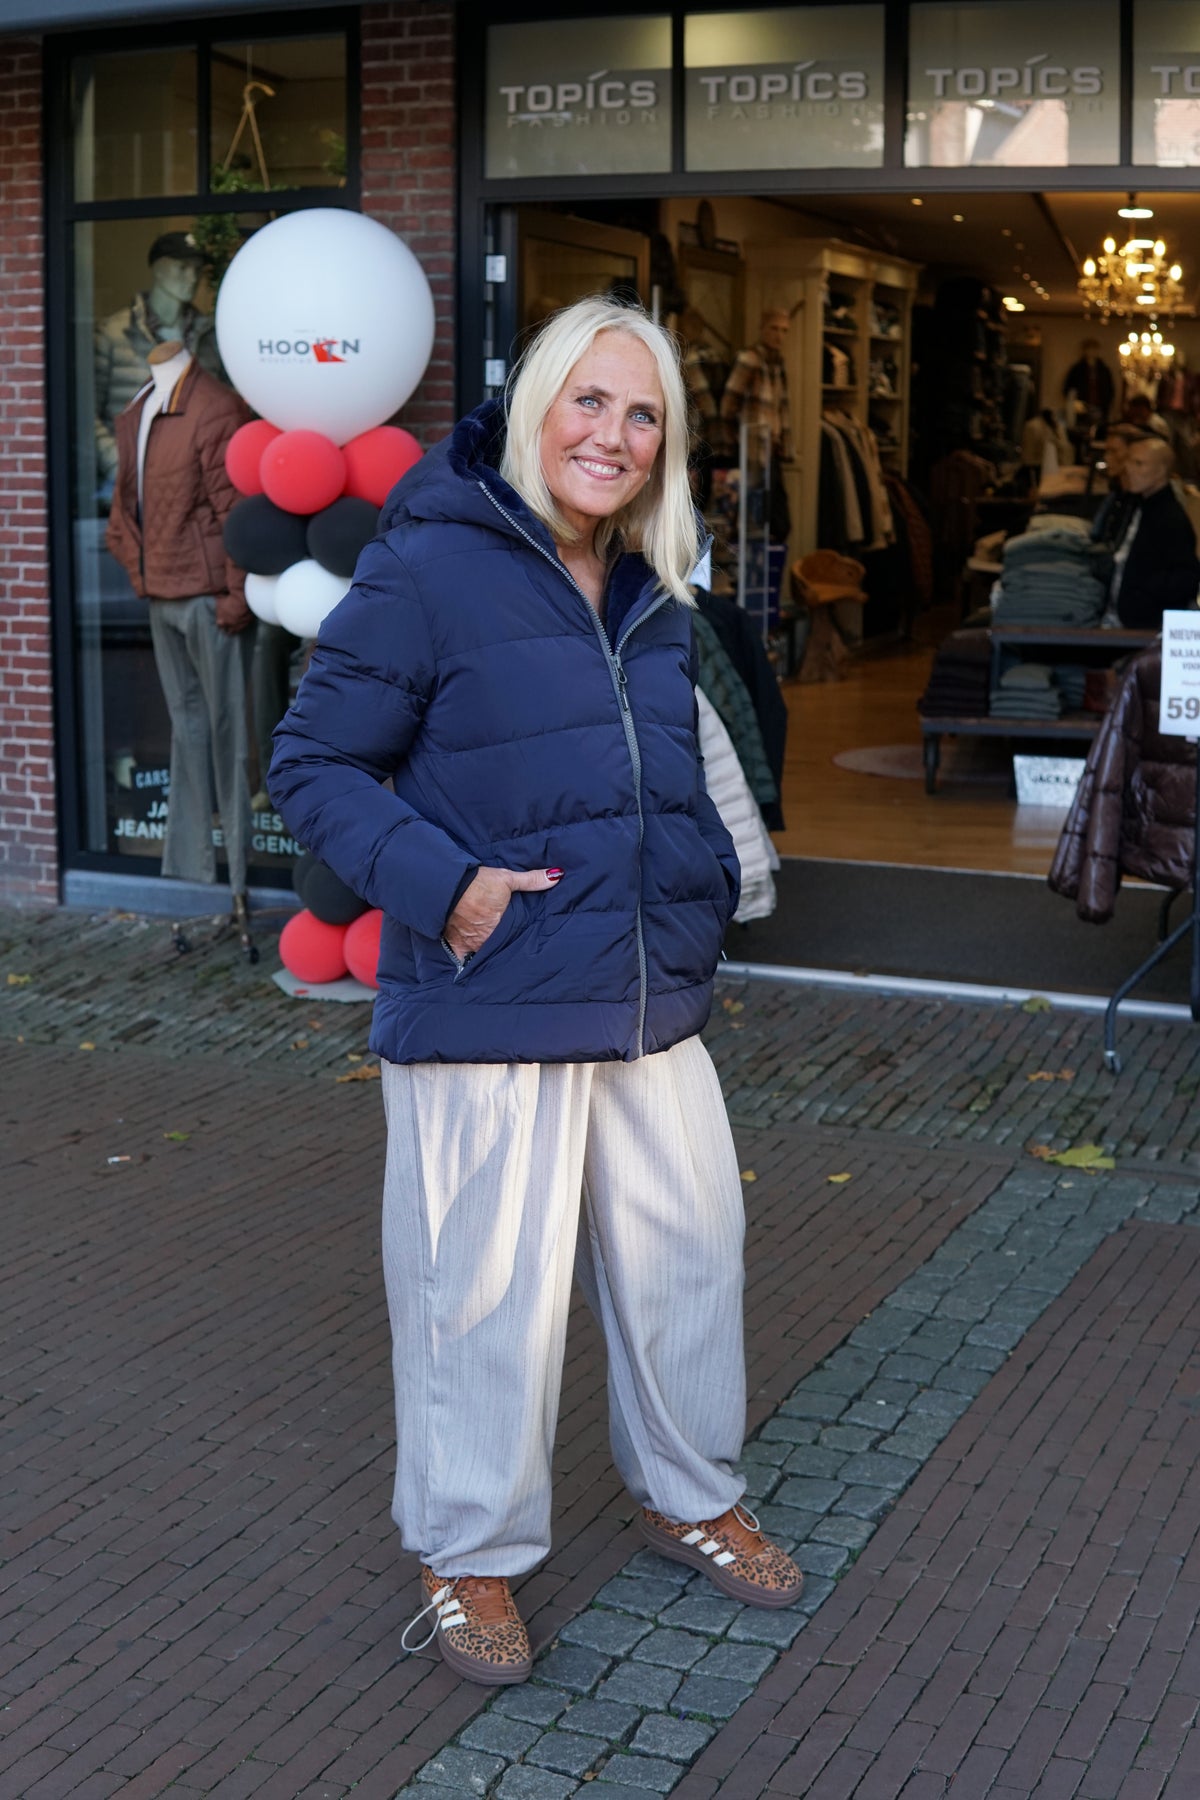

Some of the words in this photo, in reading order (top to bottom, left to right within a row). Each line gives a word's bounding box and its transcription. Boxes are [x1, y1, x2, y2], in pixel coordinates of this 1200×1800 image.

[499, 69, 656, 113] TOPÍCS
[699, 60, 866, 105] TOPÍCS
[925, 53, 1103, 97] TOPÍCS
[506, 110, 656, 129] FASHION
[707, 102, 867, 120] FASHION
[114, 817, 169, 840] JEAN
